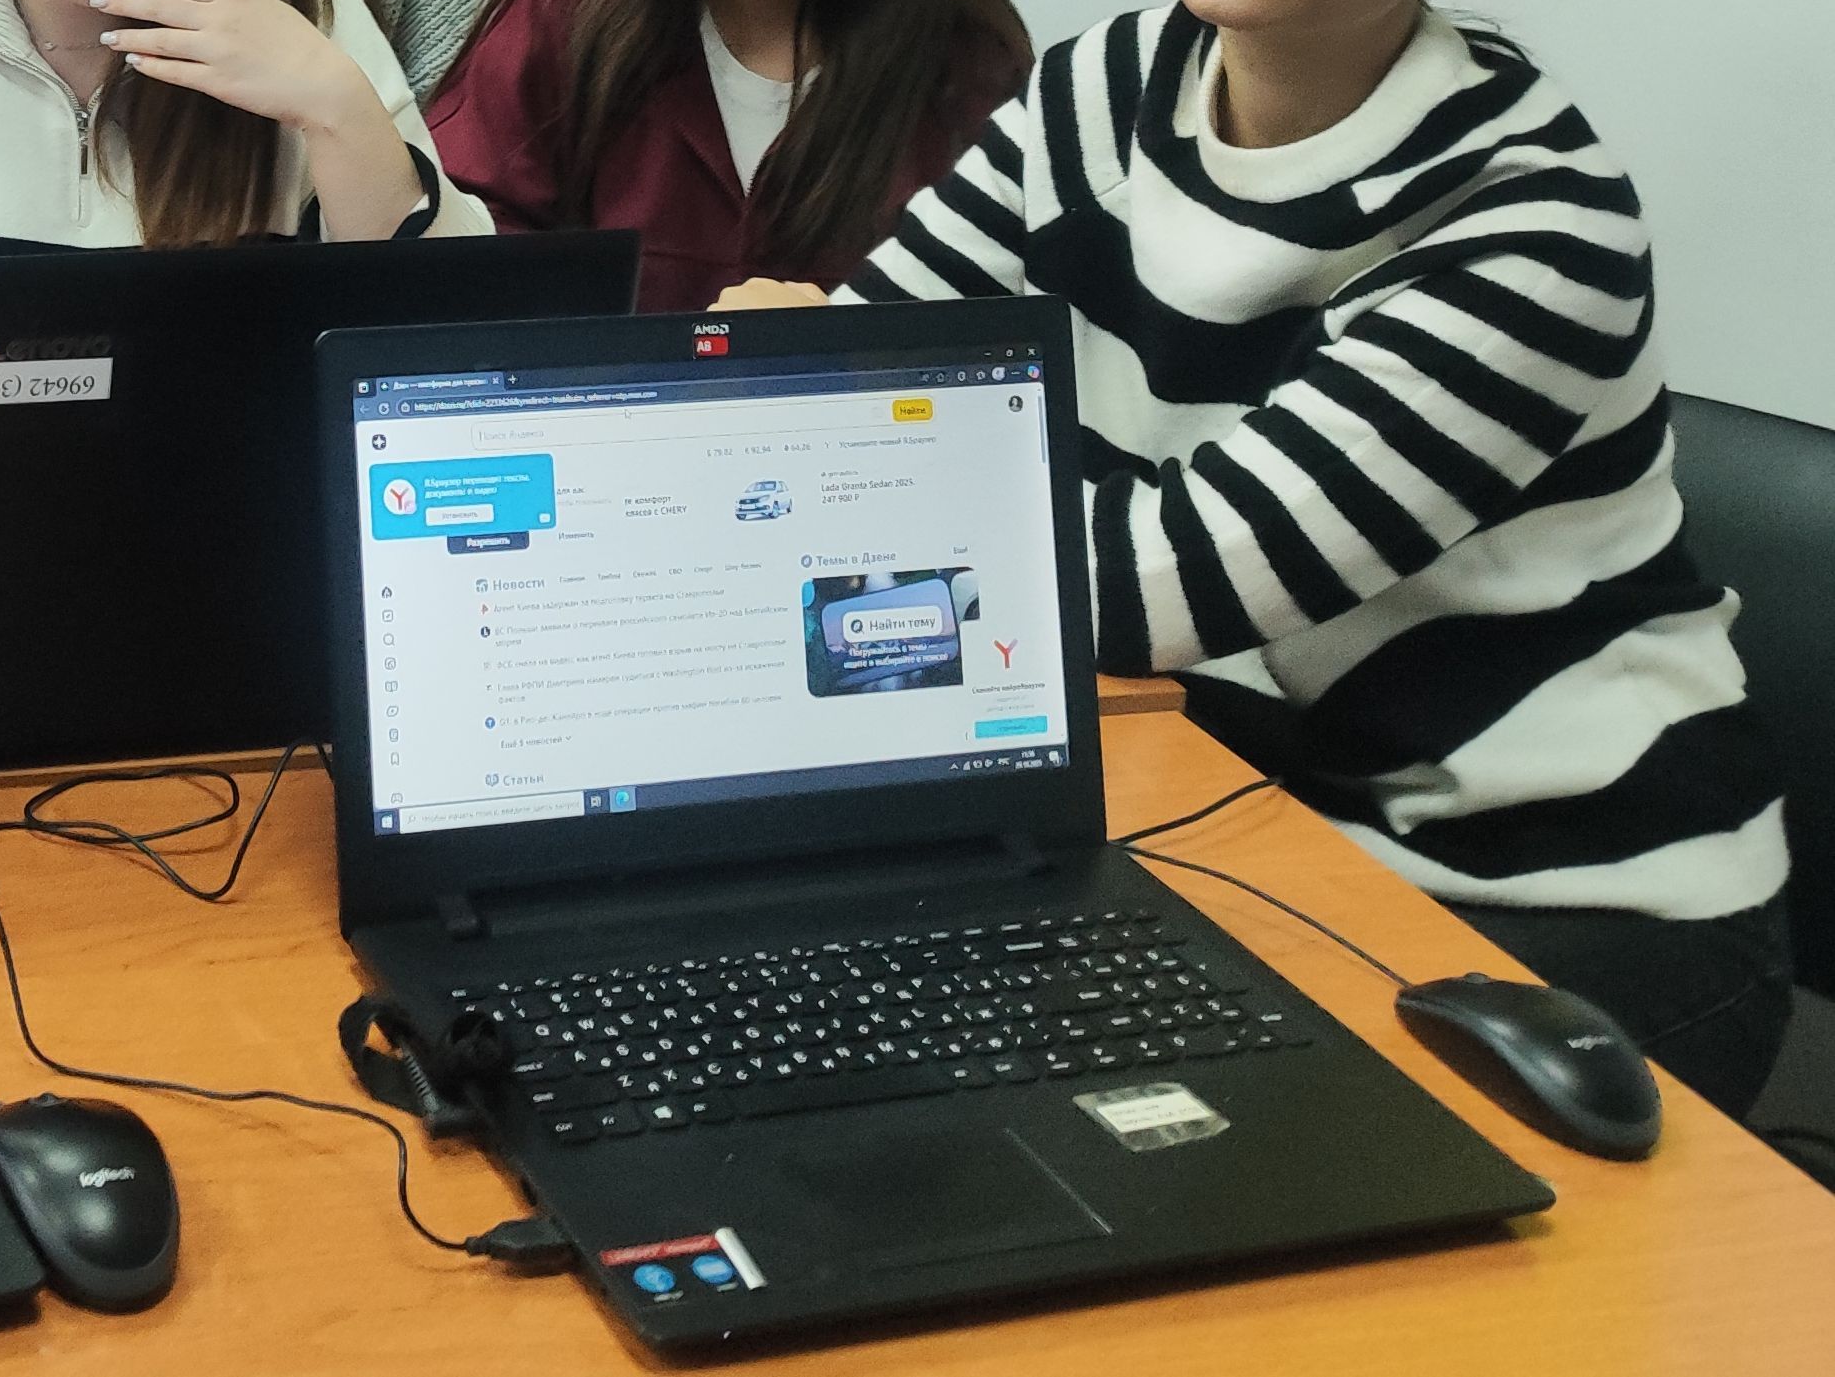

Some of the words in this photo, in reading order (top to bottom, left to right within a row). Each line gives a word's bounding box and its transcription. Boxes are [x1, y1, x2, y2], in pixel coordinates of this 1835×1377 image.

[694, 324, 721, 335] AMD
[29, 376, 95, 397] 69642
[661, 506, 687, 515] CHERY
[816, 555, 848, 567] Темы
[861, 551, 897, 566] Дзене
[492, 576, 545, 591] Новости
[869, 618, 906, 633] Найти
[908, 616, 936, 631] тему
[502, 770, 544, 788] Статьи
